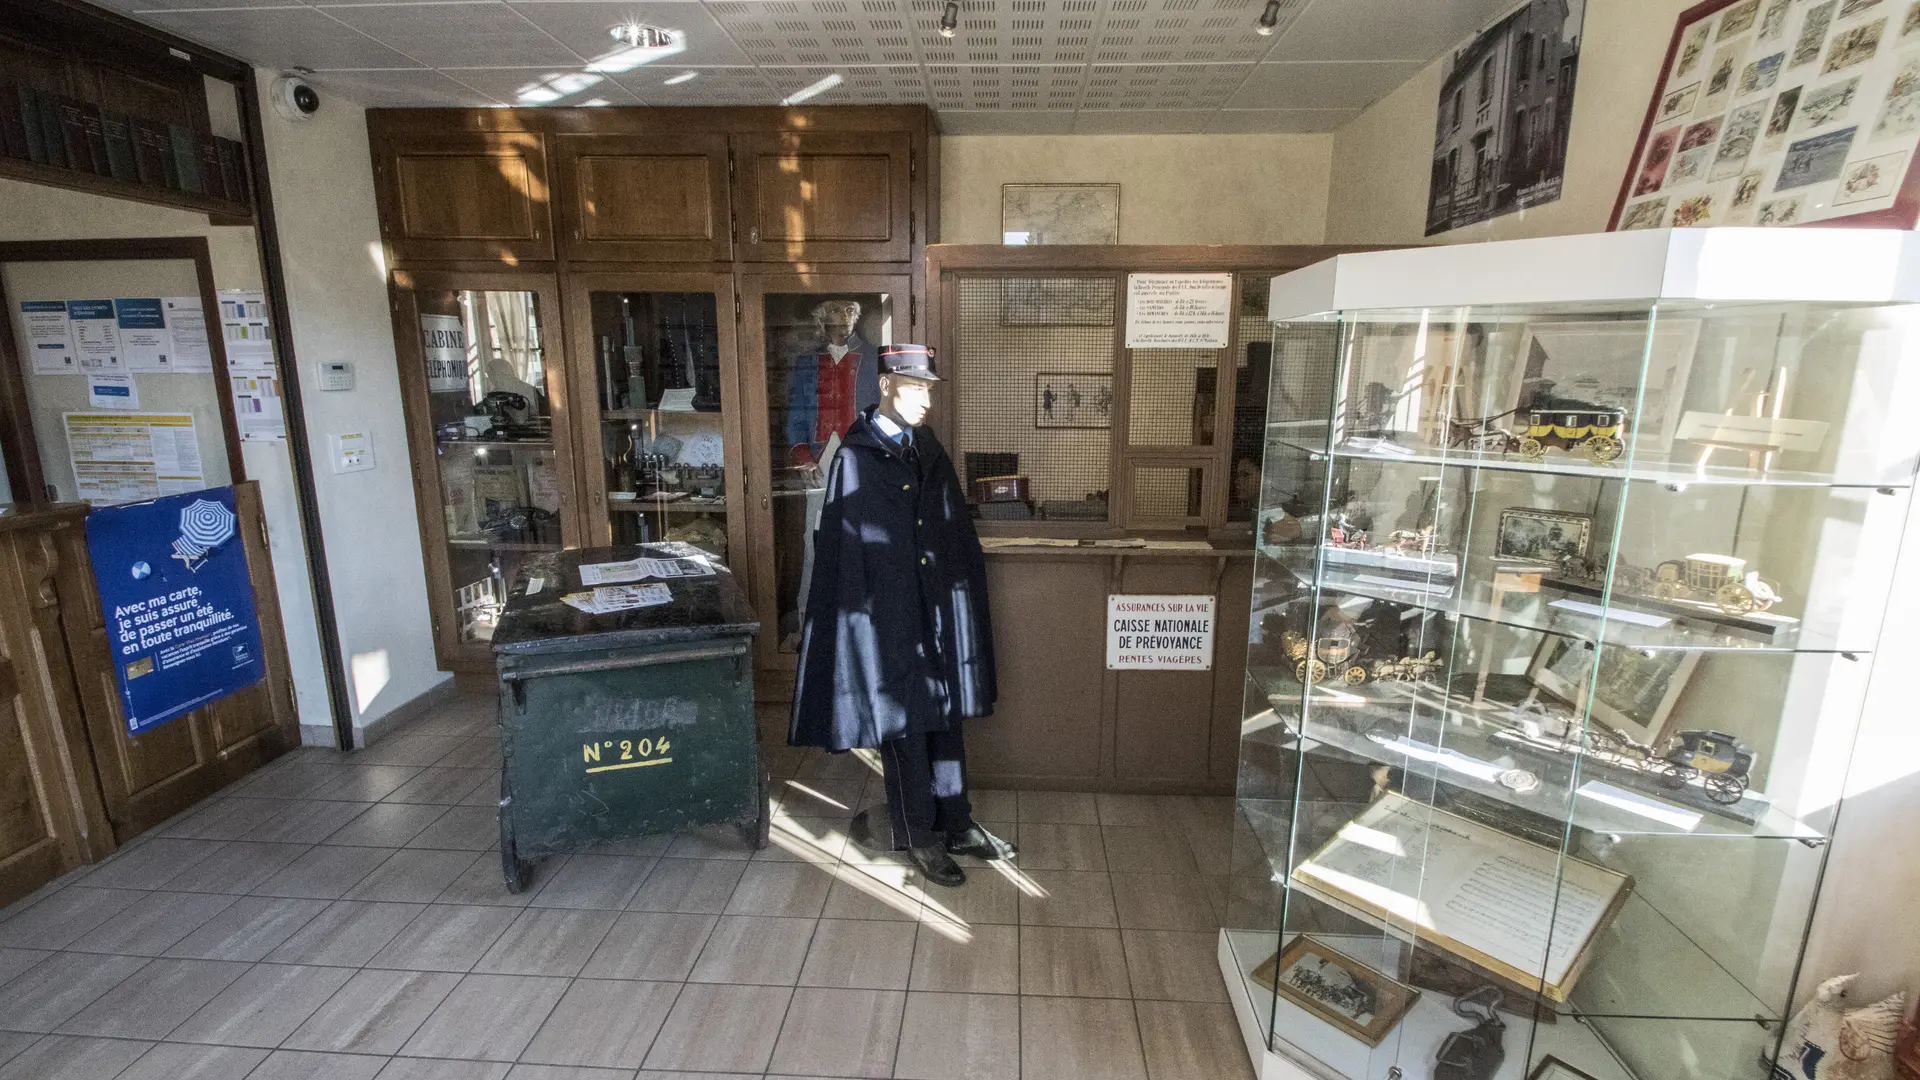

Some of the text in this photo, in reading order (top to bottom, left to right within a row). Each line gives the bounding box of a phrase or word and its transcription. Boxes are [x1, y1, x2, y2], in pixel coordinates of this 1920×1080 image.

[424, 330, 464, 348] CABINE
[115, 586, 202, 618] Avec ma carte,
[1116, 603, 1208, 612] ASSURANCES SUR LA VIE
[119, 596, 198, 634] je suis assuré
[120, 602, 214, 642] de passer un été
[1114, 620, 1209, 632] CAISSE NATIONALE
[122, 608, 234, 655] en toute tranquillité.
[1119, 634, 1202, 650] DE PRÉVOYANCE
[1118, 654, 1202, 664] RENTES VIAGÈRES
[583, 736, 671, 762] N° 204
